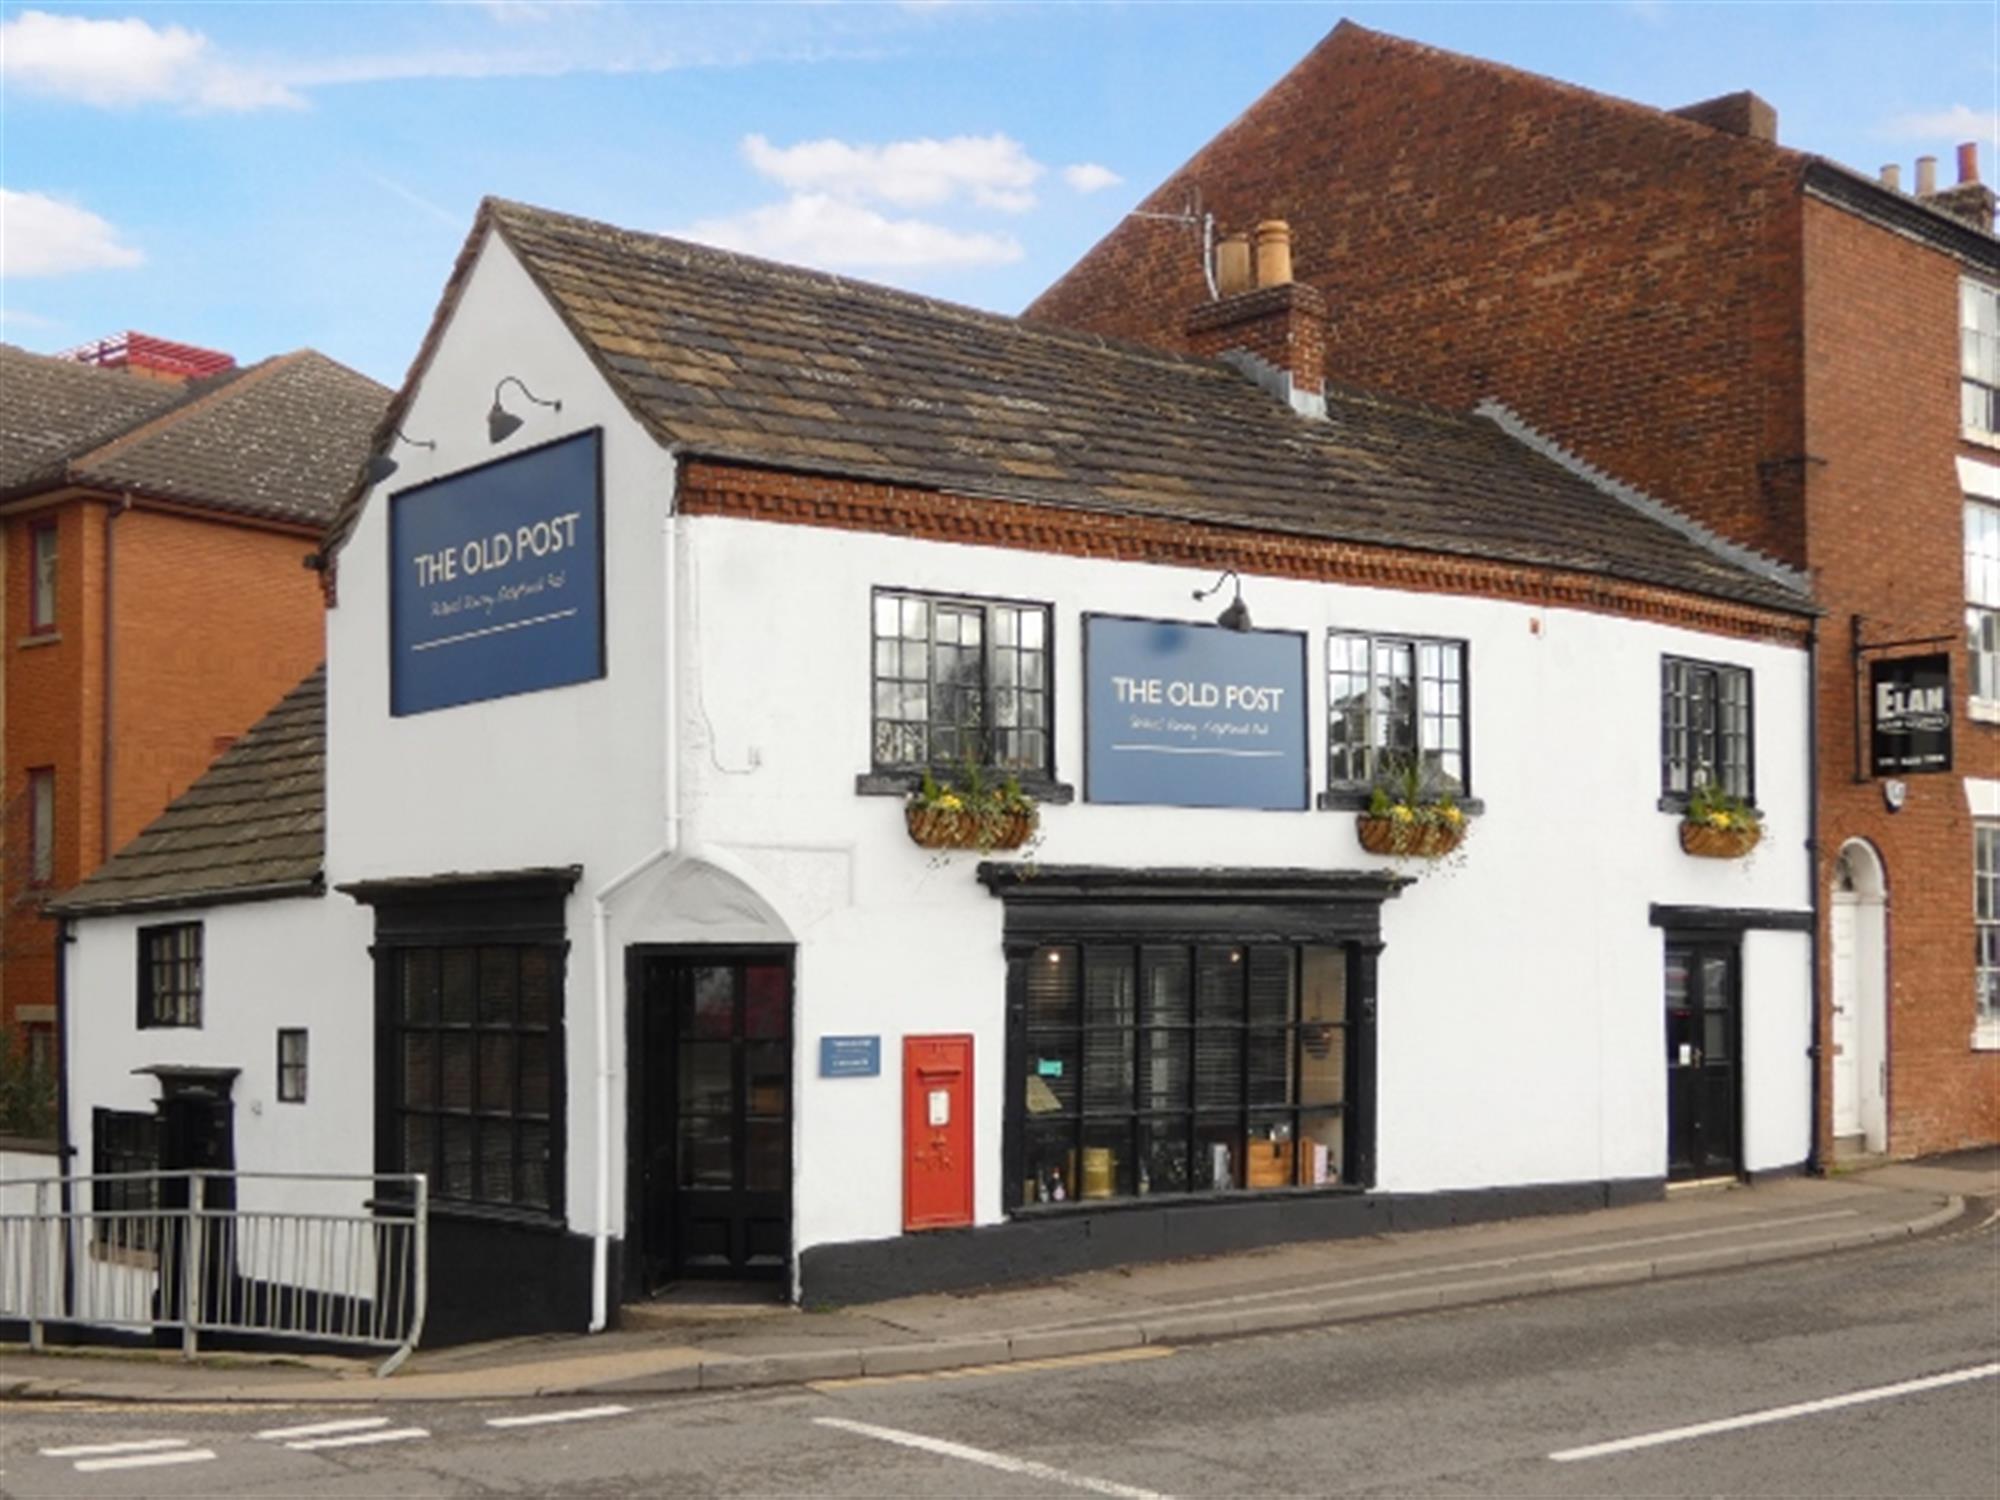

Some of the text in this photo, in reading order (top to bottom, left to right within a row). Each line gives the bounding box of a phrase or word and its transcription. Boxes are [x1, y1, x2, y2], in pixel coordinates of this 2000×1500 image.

[414, 512, 580, 587] THE OLD POST
[1112, 677, 1284, 712] THE OLD POST
[1877, 682, 1944, 719] ELAN
